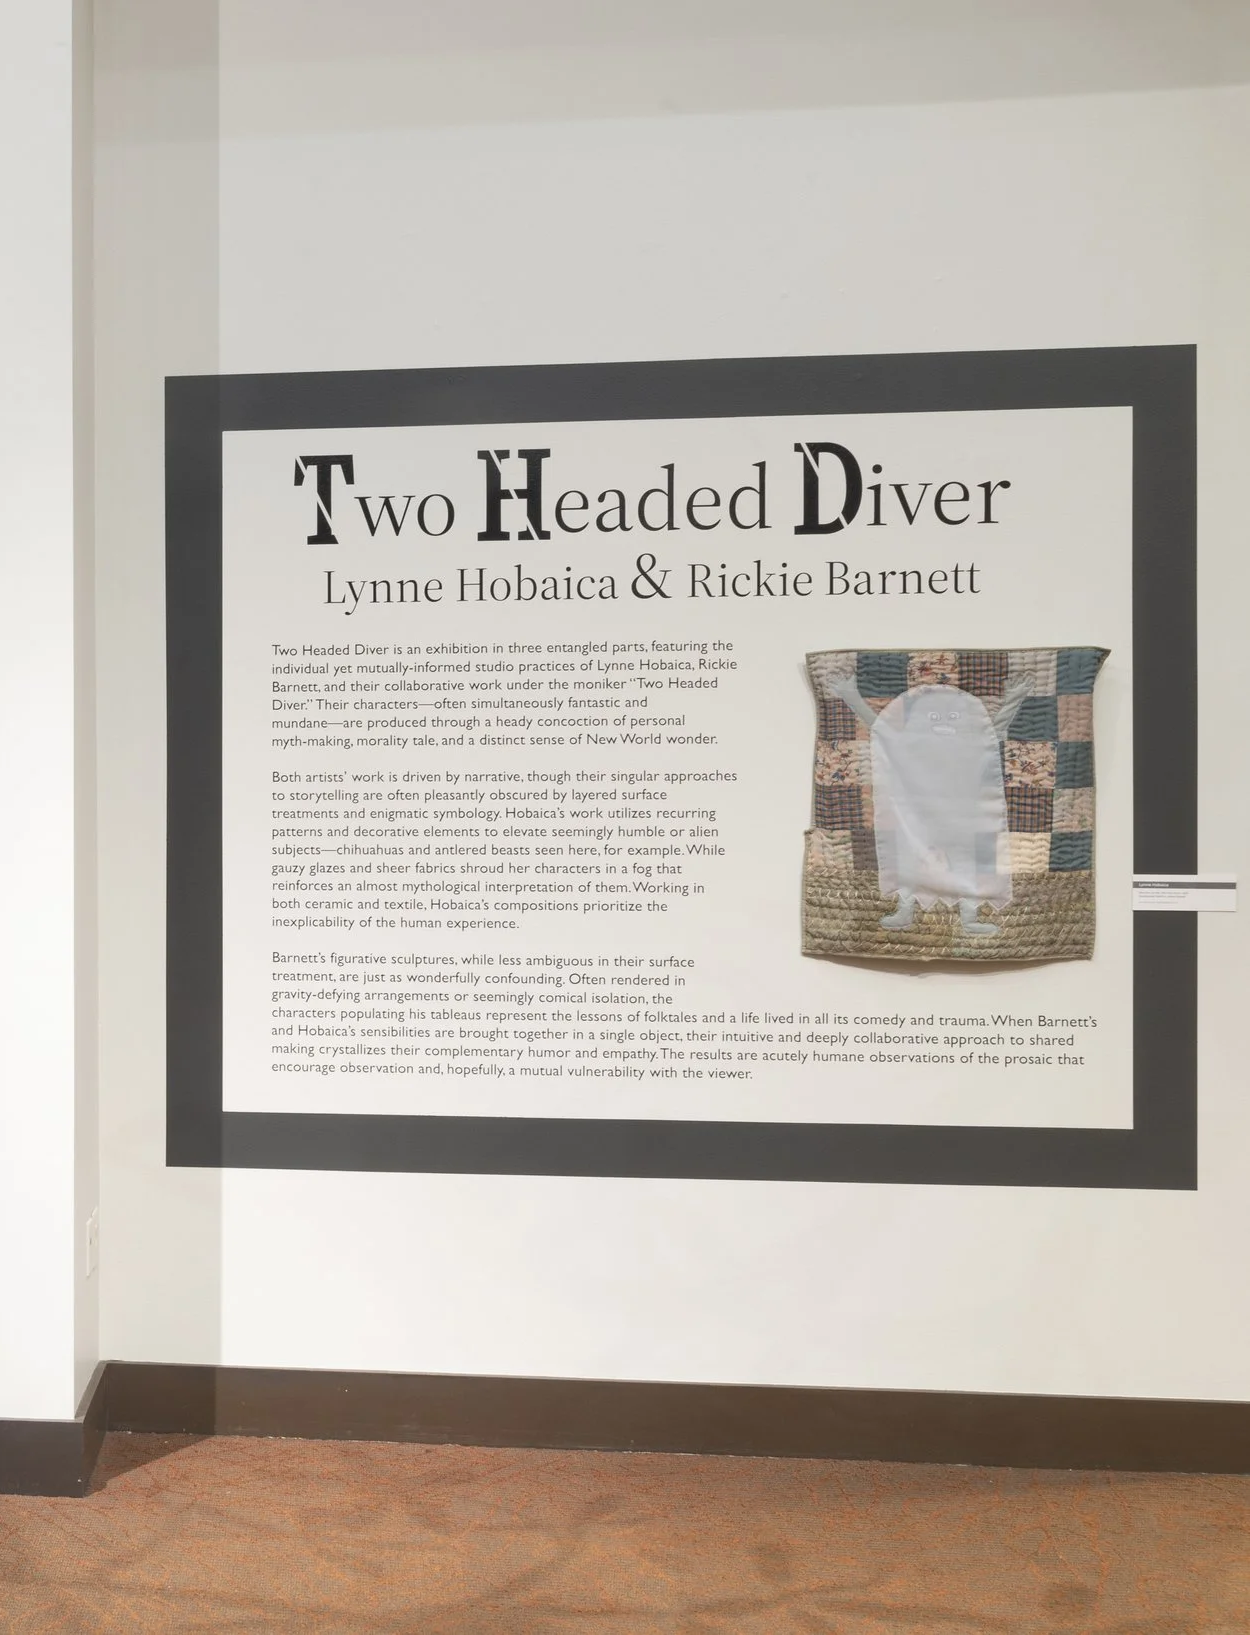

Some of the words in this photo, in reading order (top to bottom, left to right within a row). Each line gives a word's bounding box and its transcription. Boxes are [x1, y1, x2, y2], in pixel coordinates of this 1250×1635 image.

[293, 454, 455, 546] Two
[476, 448, 772, 542] Headed
[793, 441, 1012, 536] Diver
[324, 570, 443, 616] Lynne
[456, 563, 619, 602] Hobaica
[631, 552, 672, 600] &
[688, 559, 813, 598] Rickie
[825, 561, 981, 596] Barnett
[271, 644, 298, 656] Two
[302, 644, 350, 656] Headed
[354, 643, 389, 655] Diver
[393, 644, 403, 655] is
[406, 646, 421, 655] an
[425, 642, 488, 655] exhibition
[493, 643, 504, 654] in
[508, 642, 542, 654] three
[546, 641, 608, 656] entangled
[612, 643, 648, 656] parts,
[651, 640, 708, 655] featuring
[712, 639, 733, 651] the
[272, 662, 329, 675] individual
[333, 665, 353, 677] yet
[357, 660, 471, 677] mutually-informed
[475, 660, 514, 672] studio
[518, 660, 575, 675] practices
[580, 659, 594, 671] of
[597, 659, 635, 675] Lynne
[639, 658, 695, 671] Hobaica,
[698, 658, 738, 670] Rickie
[272, 681, 321, 693] Barnett,
[324, 680, 346, 692] and
[350, 680, 380, 692] their
[384, 679, 465, 692] collaborative
[468, 679, 502, 691] work
[506, 678, 544, 690] under
[548, 678, 569, 690] the
[573, 677, 627, 690] moniker
[668, 676, 718, 689] Headed
[272, 735, 354, 750] myth-making,
[356, 734, 409, 750] morality
[412, 734, 439, 747] tale,
[441, 734, 464, 746] and
[468, 737, 475, 746] a
[479, 733, 526, 746] distinct
[529, 736, 565, 745] sense
[569, 733, 583, 745] of
[586, 733, 618, 745] New
[619, 733, 662, 745] World
[666, 732, 718, 745] wonder.
[272, 771, 301, 783] Both
[351, 771, 385, 783] work
[389, 771, 398, 783] is
[402, 770, 441, 782] driven
[446, 770, 460, 786] by
[464, 771, 524, 783] narrative,
[527, 770, 571, 786] though
[576, 770, 607, 782] their
[611, 770, 660, 785] singular
[664, 769, 738, 785] approaches
[272, 792, 285, 801] to
[289, 789, 359, 804] storytelling
[363, 792, 383, 801] are
[387, 789, 420, 801] often
[424, 789, 486, 804] pleasantly
[489, 788, 548, 801] obscured
[553, 788, 568, 804] by
[572, 788, 617, 804] layered
[621, 788, 667, 800] surface
[272, 828, 323, 840] patterns
[327, 825, 349, 837] and
[353, 825, 419, 837] decorative
[423, 825, 480, 837] elements
[484, 828, 498, 837] to
[502, 825, 547, 837] elevate
[552, 825, 614, 841] seemingly
[618, 825, 665, 837] humble
[669, 829, 685, 837] or
[689, 825, 719, 837] alien
[272, 915, 355, 931] inexplicability
[359, 916, 373, 928] of
[375, 916, 396, 928] the
[400, 916, 442, 928] human
[446, 917, 520, 932] experience.
[330, 952, 387, 967] figurative
[391, 953, 458, 968] sculptures,
[460, 953, 494, 965] while
[499, 954, 522, 966] less
[526, 954, 594, 970] ambiguous
[598, 955, 609, 967] in
[614, 955, 645, 967] their
[649, 955, 695, 968] surface
[271, 1006, 336, 1019] characters
[340, 1007, 405, 1023] populating
[409, 1008, 426, 1020] his
[430, 1008, 481, 1021] tableaus
[486, 1012, 548, 1024] represent
[551, 1009, 572, 1022] the
[577, 1009, 623, 1022] lessons
[627, 1010, 641, 1022] of
[644, 1010, 698, 1023] folktales
[702, 1011, 725, 1023] and
[729, 1015, 737, 1023] a
[741, 1011, 760, 1024] life
[764, 1012, 794, 1024] lived
[799, 1013, 810, 1024] in
[814, 1012, 829, 1025] all
[833, 1013, 849, 1025] its
[853, 1013, 906, 1029] comedy
[910, 1014, 934, 1026] and
[939, 1017, 990, 1027] trauma.
[990, 1014, 1033, 1027] When
[271, 1042, 315, 1058] making
[319, 1043, 386, 1058] crystallizes
[390, 1044, 421, 1056] their
[424, 1045, 524, 1061] complementary
[528, 1046, 571, 1058] humor
[575, 1047, 598, 1059] and
[602, 1047, 659, 1063] empathy.
[659, 1047, 685, 1060] The
[690, 1048, 733, 1061] results
[737, 1052, 758, 1061] are
[762, 1050, 809, 1065] acutely
[813, 1050, 865, 1063] humane
[869, 1051, 955, 1064] observations
[960, 1051, 974, 1064] of
[977, 1052, 1000, 1064] the
[1004, 1053, 1053, 1068] prosaic
[1057, 1053, 1085, 1065] that
[271, 1063, 336, 1076] encourage
[339, 1061, 414, 1074] observation
[418, 1063, 444, 1076] and,
[447, 1063, 506, 1079] hopefully,
[508, 1067, 515, 1076] a
[520, 1065, 563, 1077] mutual
[567, 1065, 645, 1081] vulnerability
[649, 1066, 678, 1078] with
[682, 1066, 703, 1079] the
[707, 1067, 753, 1080] viewer.
